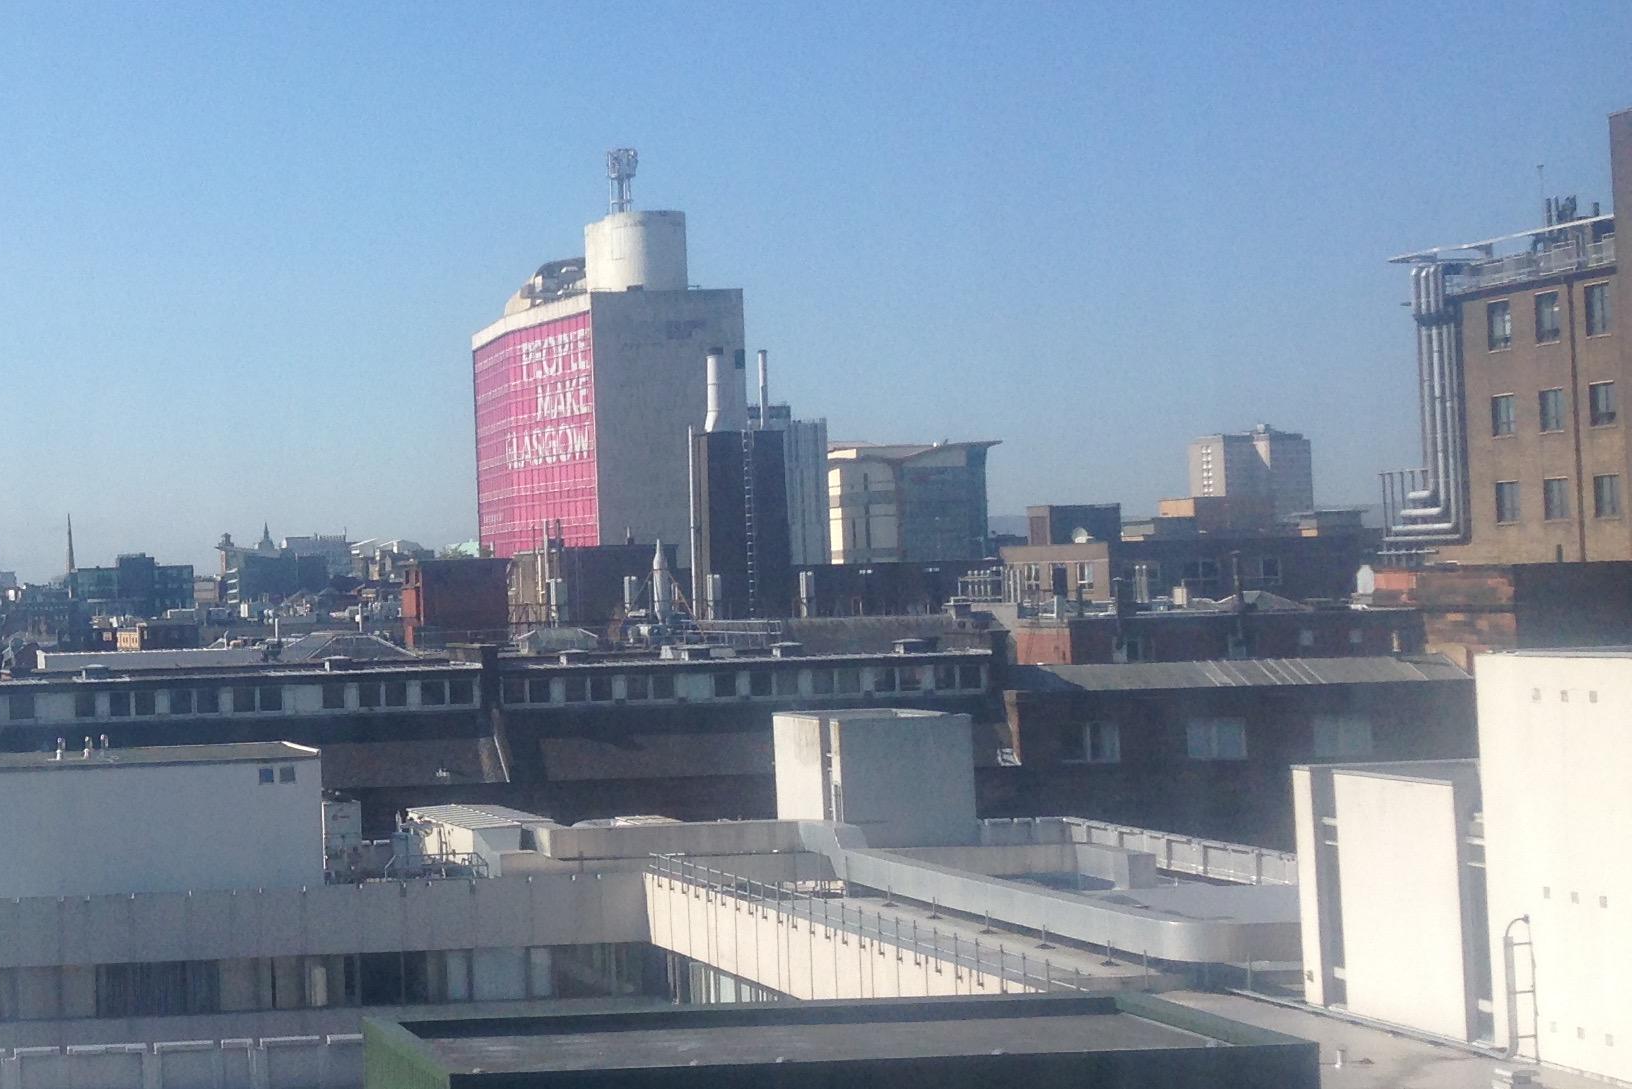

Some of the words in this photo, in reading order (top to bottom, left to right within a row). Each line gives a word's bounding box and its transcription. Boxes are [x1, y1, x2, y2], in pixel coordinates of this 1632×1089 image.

[521, 328, 590, 382] PEOPLE
[536, 377, 591, 420] MAKE
[505, 422, 589, 469] GLASGOW
